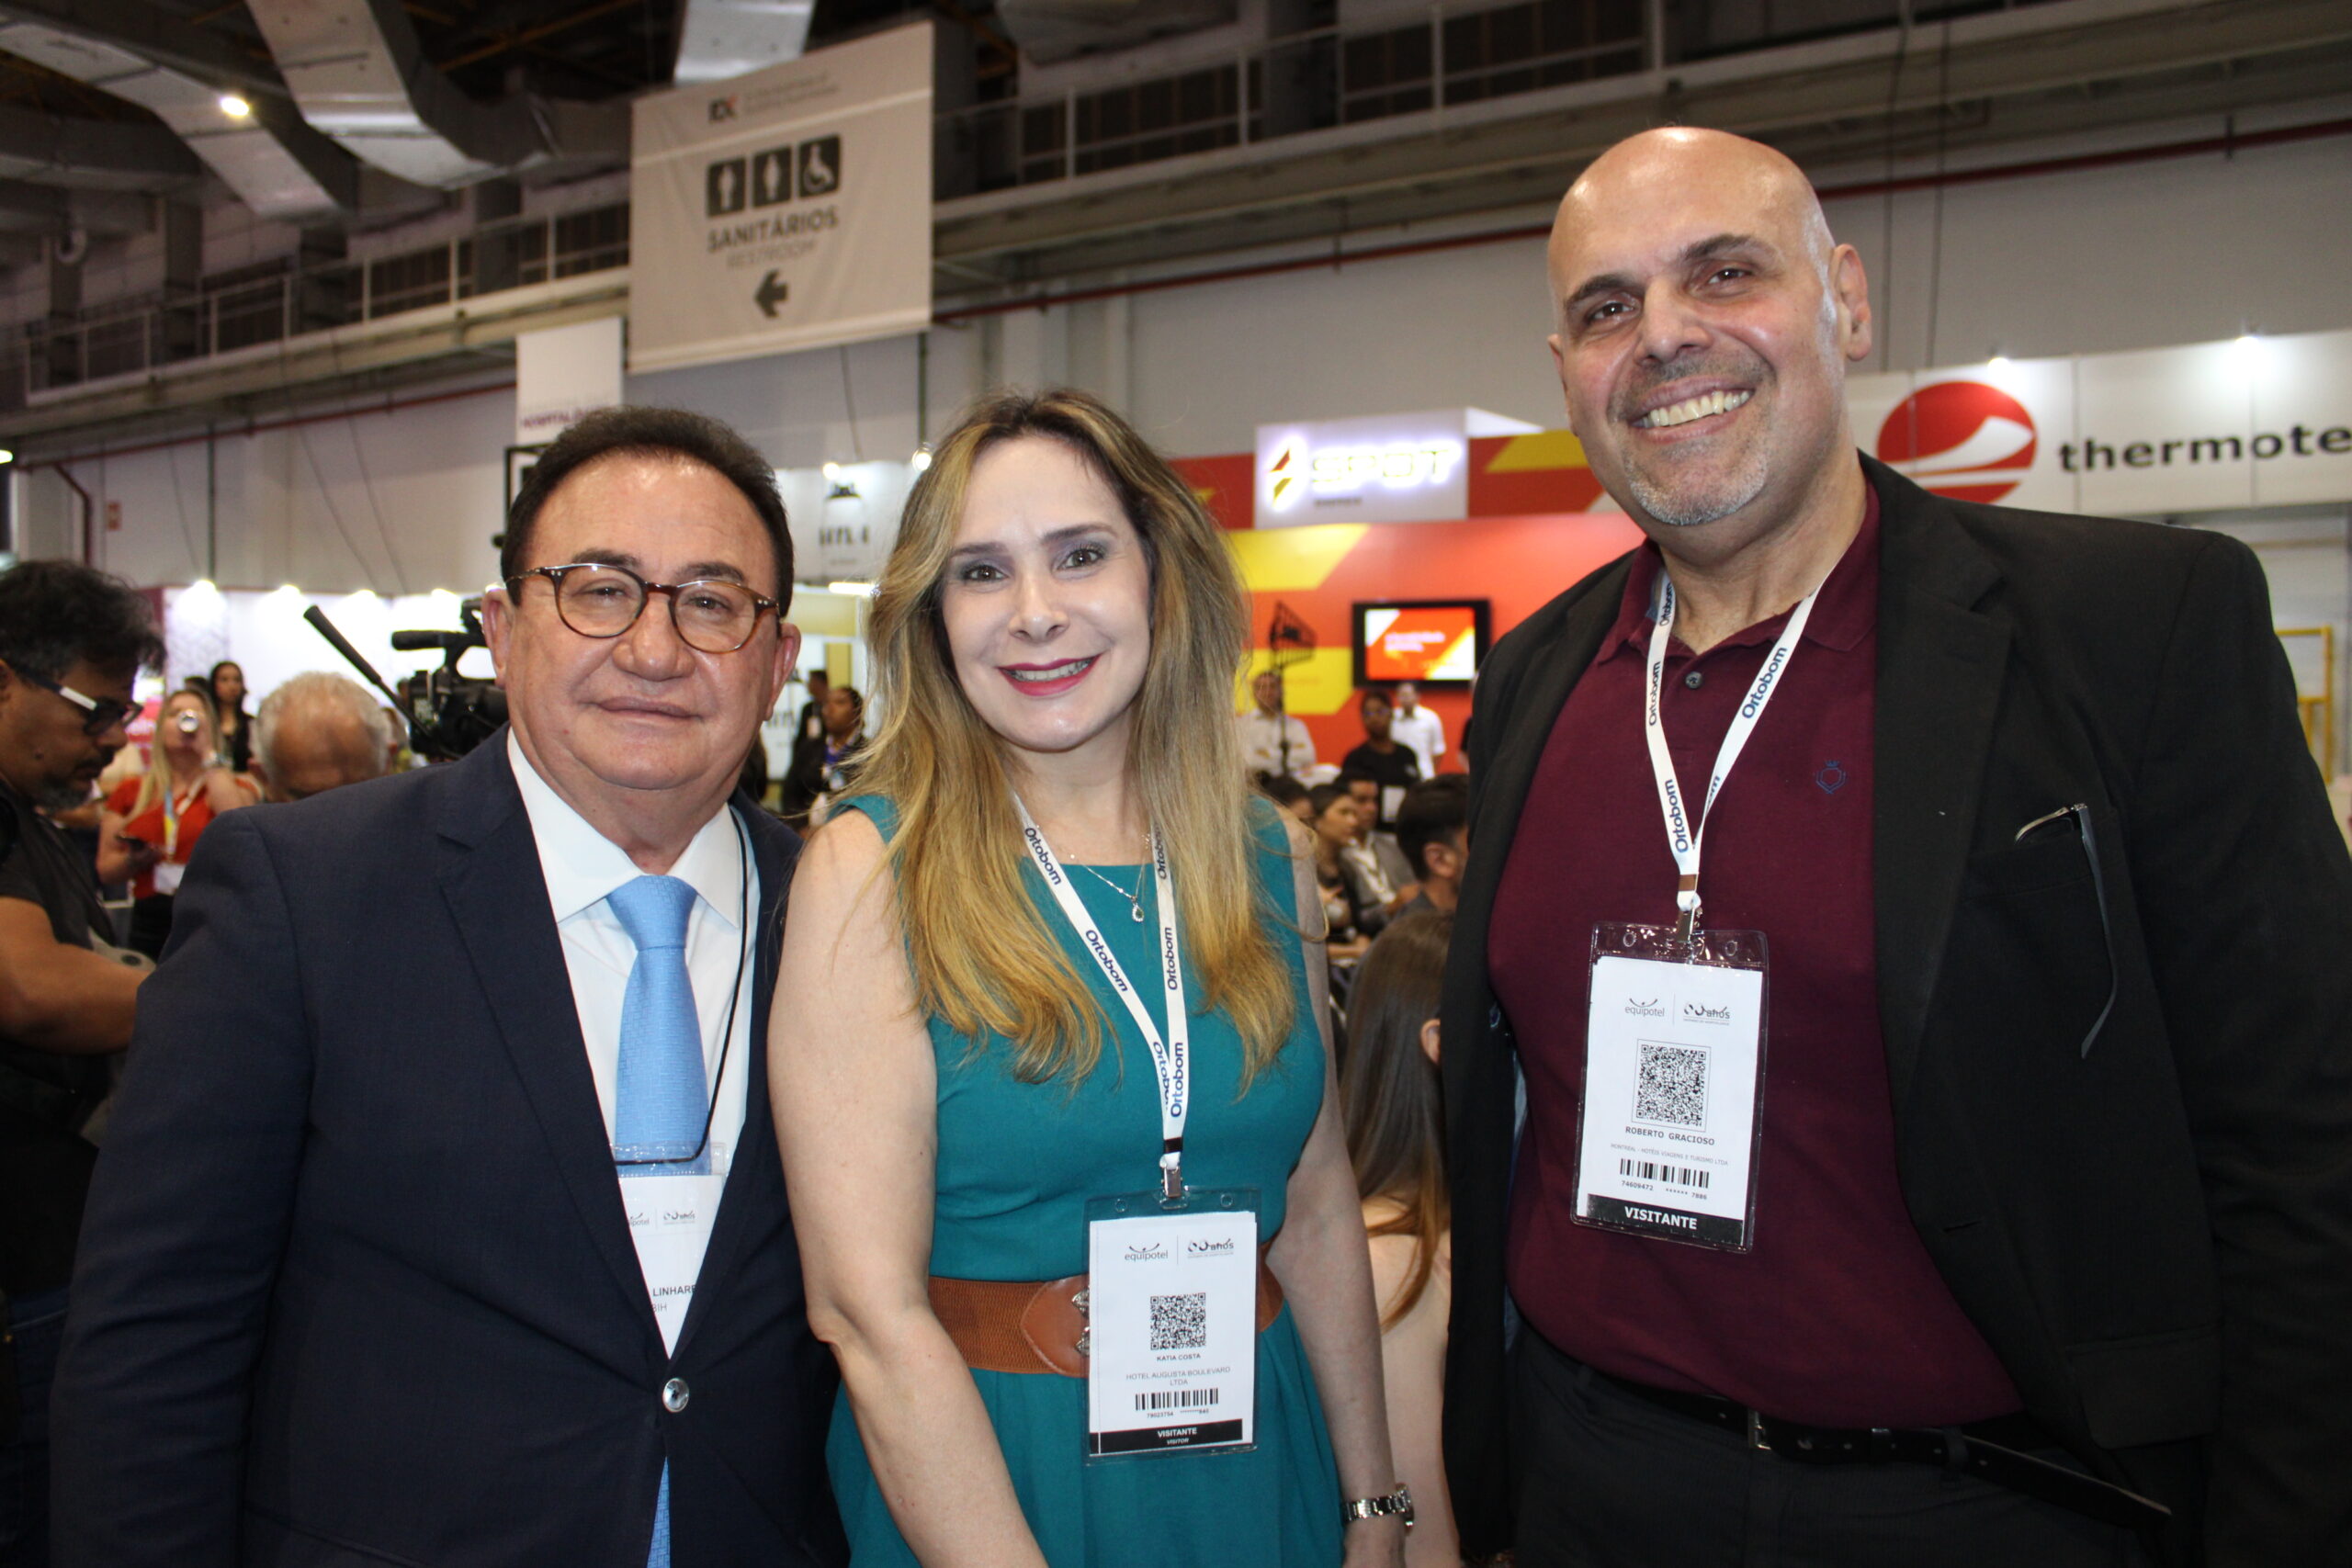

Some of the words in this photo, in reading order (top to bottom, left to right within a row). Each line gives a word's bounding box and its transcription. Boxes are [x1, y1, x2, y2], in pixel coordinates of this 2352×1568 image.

[707, 205, 838, 253] SANITÁRIOS
[1310, 443, 1459, 489] SPOT
[2059, 425, 2352, 473] thermote
[1649, 661, 1661, 726] Ortobom
[1742, 647, 1787, 719] Ortobom
[1665, 780, 1689, 853] Ortobom
[1024, 827, 1062, 886] Ortobom
[1085, 930, 1128, 992] Ortobom
[1164, 927, 1178, 990] Ortobom
[1624, 1006, 1665, 1017] equipotel
[1170, 1043, 1183, 1117] Ortobom
[1625, 1126, 1664, 1138] ROBERTO
[1668, 1133, 1715, 1145] GRACIOSO
[1624, 1206, 1697, 1230] VISITANTE
[1125, 1250, 1168, 1261] equipotel
[1126, 1372, 1149, 1381] HOTEL
[1152, 1370, 1186, 1379] AUGUSTA
[1187, 1366, 1231, 1377] BOULEVARD
[1158, 1427, 1197, 1438] VISITANTE
